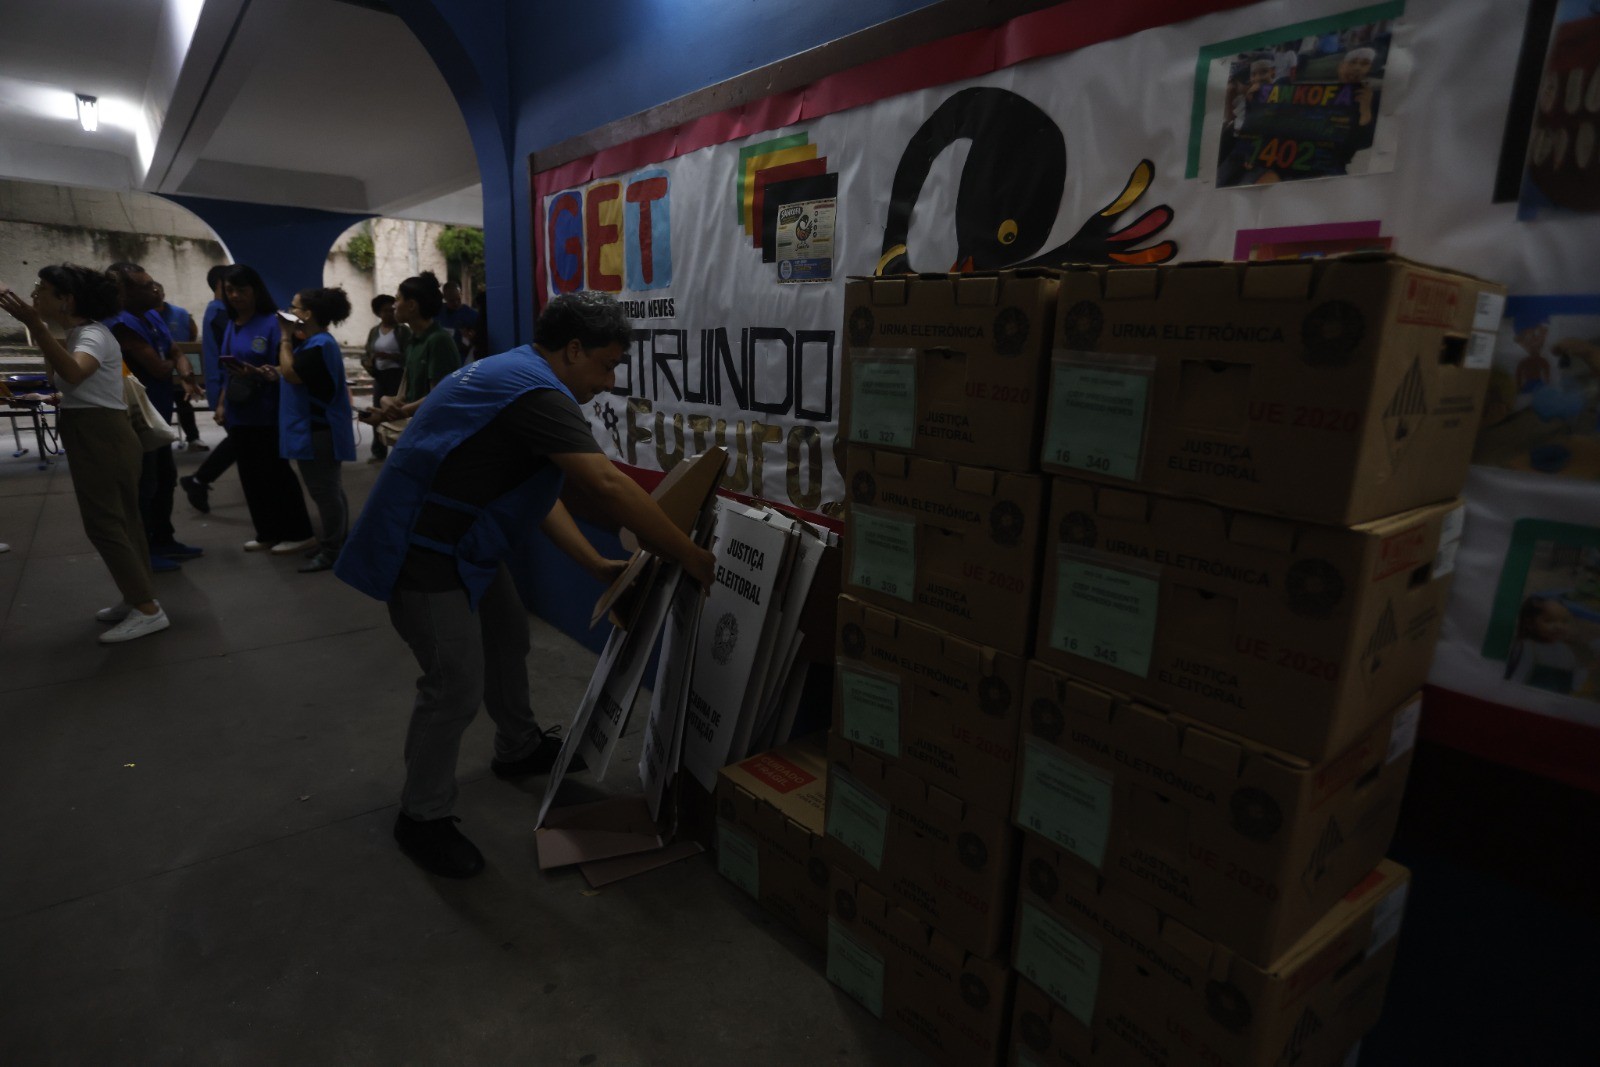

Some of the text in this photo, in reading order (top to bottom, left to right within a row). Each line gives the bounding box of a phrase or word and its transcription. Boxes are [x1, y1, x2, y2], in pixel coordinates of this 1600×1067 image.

[549, 176, 668, 293] GET
[648, 298, 675, 318] NEVES
[880, 323, 984, 338] URNA ELETRÔNICA
[1112, 323, 1285, 343] URNA ELETRÔNICA
[965, 382, 1030, 404] UE 2020
[926, 411, 969, 427] JUSTIÇA
[1249, 401, 1360, 432] UE 2020
[858, 429, 869, 439] 16
[918, 425, 975, 443] ELEITORAL
[1056, 450, 1110, 471] 16 340
[1181, 438, 1251, 460] JUSTIÇA
[1168, 456, 1261, 483] ELEITORAL
[881, 491, 982, 524] URNA ELETRÔNICA
[727, 537, 764, 572] JUSTIÇA
[1106, 539, 1150, 559] URNA
[1154, 550, 1271, 587] ELETRÔNICA
[716, 568, 760, 605] ELEITORAL
[861, 575, 871, 586] 16
[963, 562, 1024, 594] UE 2020
[926, 583, 967, 604] JUSTIÇA
[919, 594, 972, 620] ELEITORAL
[871, 645, 898, 664] URNA
[1063, 636, 1117, 663] 16 345
[1234, 634, 1339, 682] UE 2020
[1171, 657, 1239, 688] JUSTIÇA
[1158, 670, 1247, 709] ELEITORAL
[710, 709, 721, 728] DE
[952, 723, 1012, 764] UE 2020
[1072, 729, 1111, 754] URNA
[761, 756, 805, 785] CUIDADO
[1188, 841, 1280, 901] UE 2020
